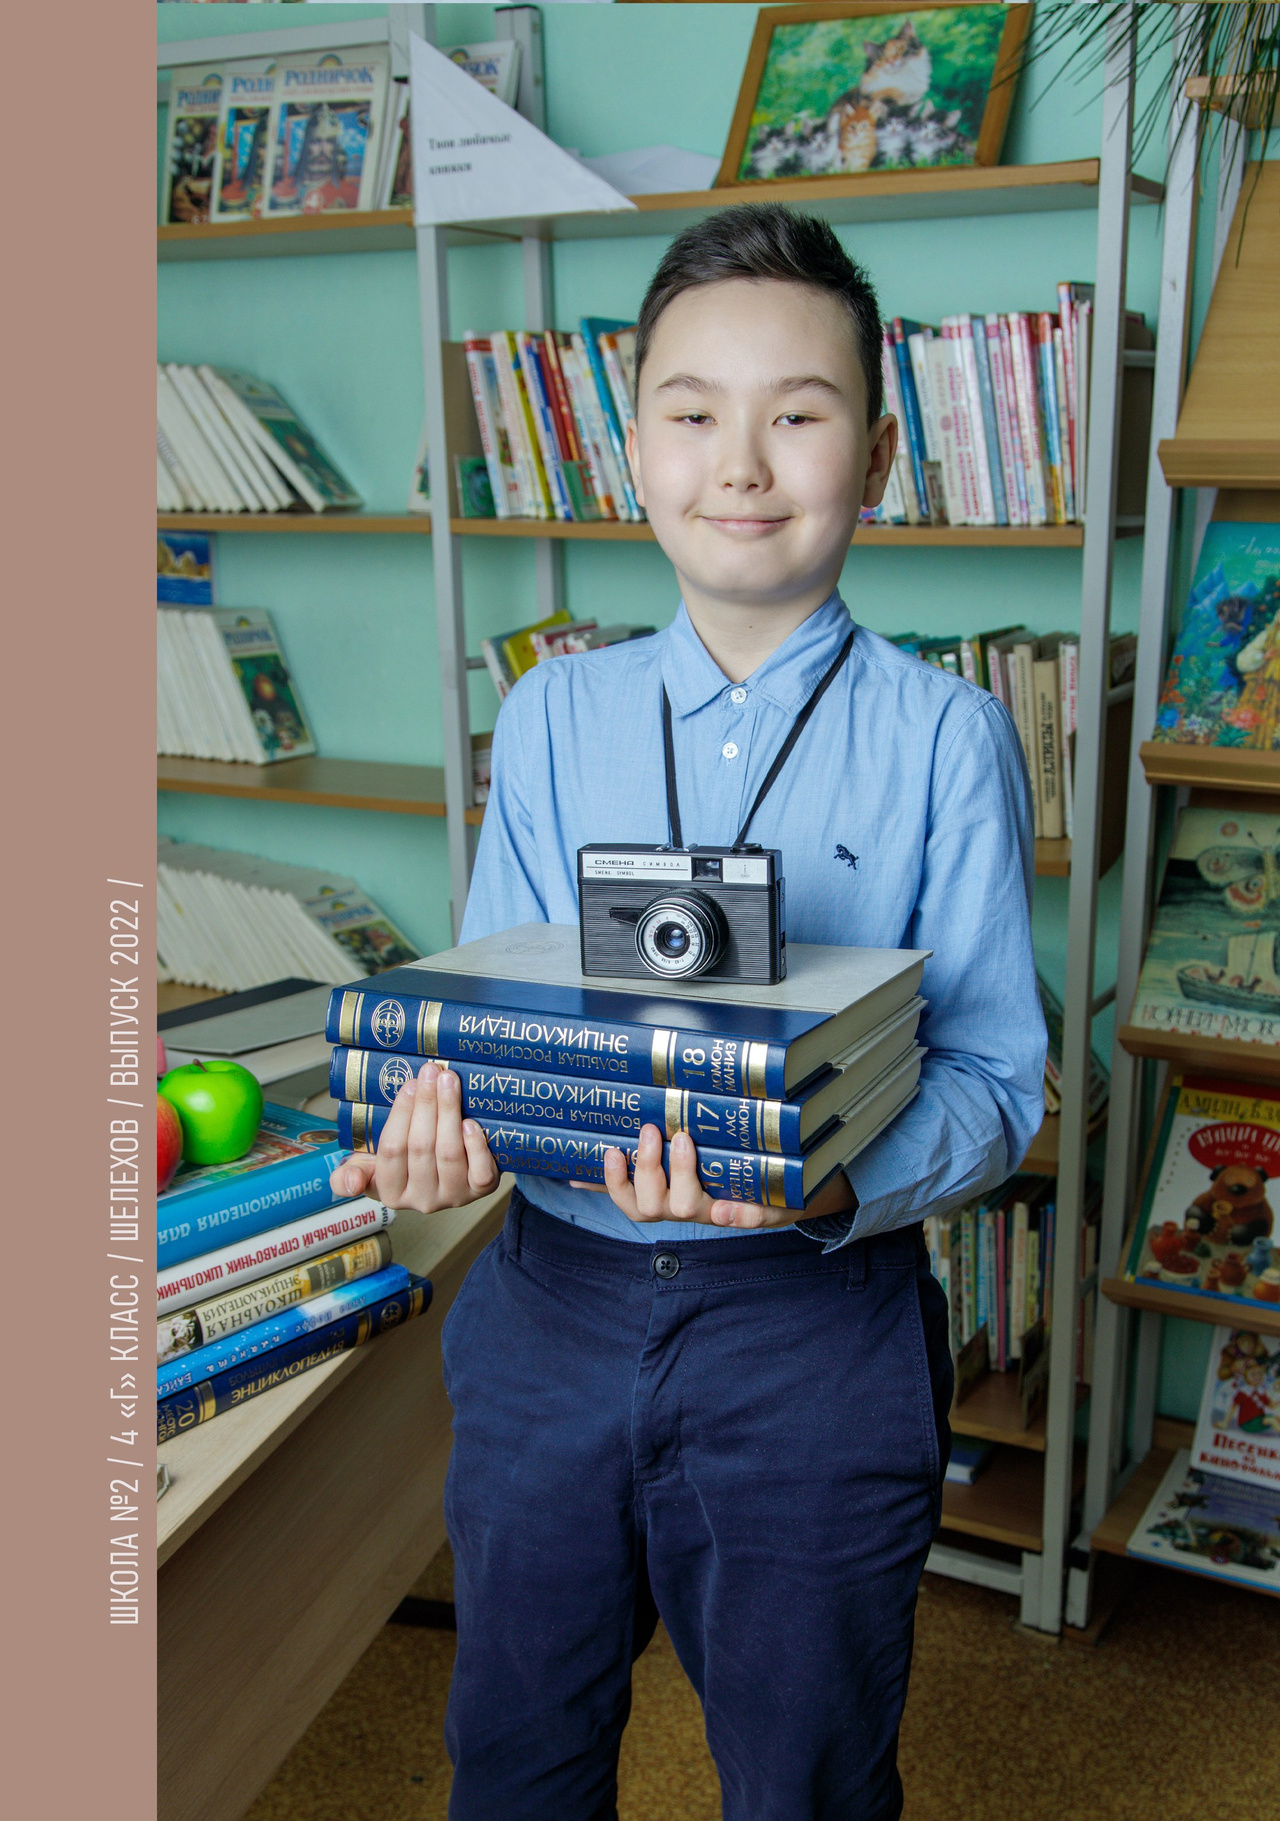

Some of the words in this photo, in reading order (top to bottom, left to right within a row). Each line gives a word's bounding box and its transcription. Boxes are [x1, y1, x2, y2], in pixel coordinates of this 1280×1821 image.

[458, 1014, 629, 1054] ЭНЦИКЛОПЕДИЯ
[458, 1038, 552, 1063] РОССИЙСКАЯ
[558, 1051, 629, 1073] БОЛЬШАЯ
[682, 1048, 706, 1079] 18
[711, 1039, 725, 1092] ЛОМОН
[723, 1042, 737, 1092] МАНИЗ
[468, 1072, 641, 1112] ЭНЦИКЛОПЕДИЯ
[468, 1096, 564, 1120] РОССИЙСКАЯ
[570, 1109, 641, 1130] БОЛЬШАЯ
[696, 1101, 720, 1132] 17
[725, 1109, 737, 1137] ЛАС
[738, 1098, 751, 1150] ЛОМОН
[700, 1161, 725, 1190] 16
[196, 1177, 323, 1232] ЭНЦИКЛОПЕДИЯ
[158, 1227, 191, 1246] ДЛЯ
[302, 1209, 377, 1249] НАСТОЛЬНЫЙ
[226, 1240, 301, 1276] СПРАВОЧНИК
[201, 1273, 302, 1323] ЭНЦИКЛОПЕДИЯ
[206, 1287, 303, 1340] ШКОЛЬНАЯ
[230, 1340, 345, 1404] ЭНЦИКЛОПЕДИЯ
[176, 1400, 196, 1428] 20
